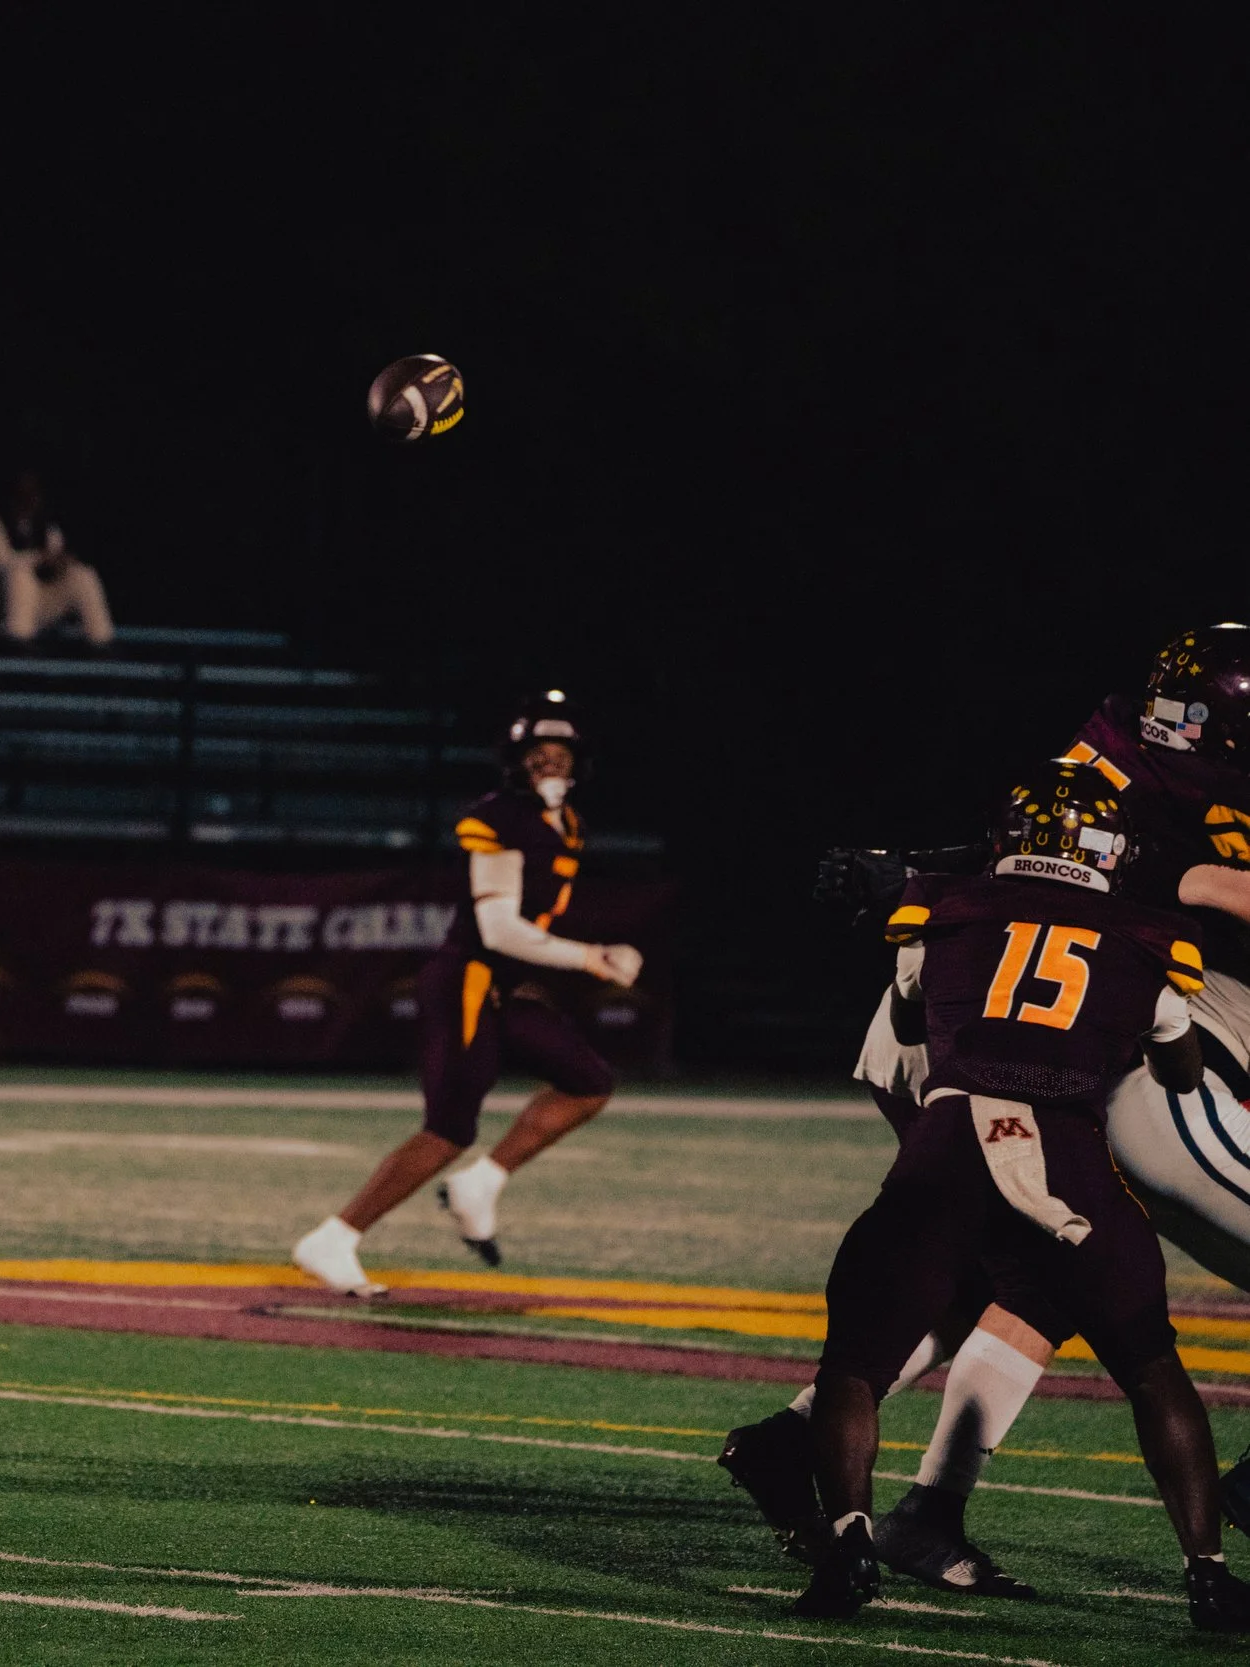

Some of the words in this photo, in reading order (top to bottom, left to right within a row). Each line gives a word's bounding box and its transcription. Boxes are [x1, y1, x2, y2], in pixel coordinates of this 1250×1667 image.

[1013, 858, 1091, 883] BRONCOS
[162, 899, 320, 951] STATE
[322, 901, 458, 951] CHAM
[981, 920, 1101, 1031] 15
[986, 1116, 1034, 1142] M
